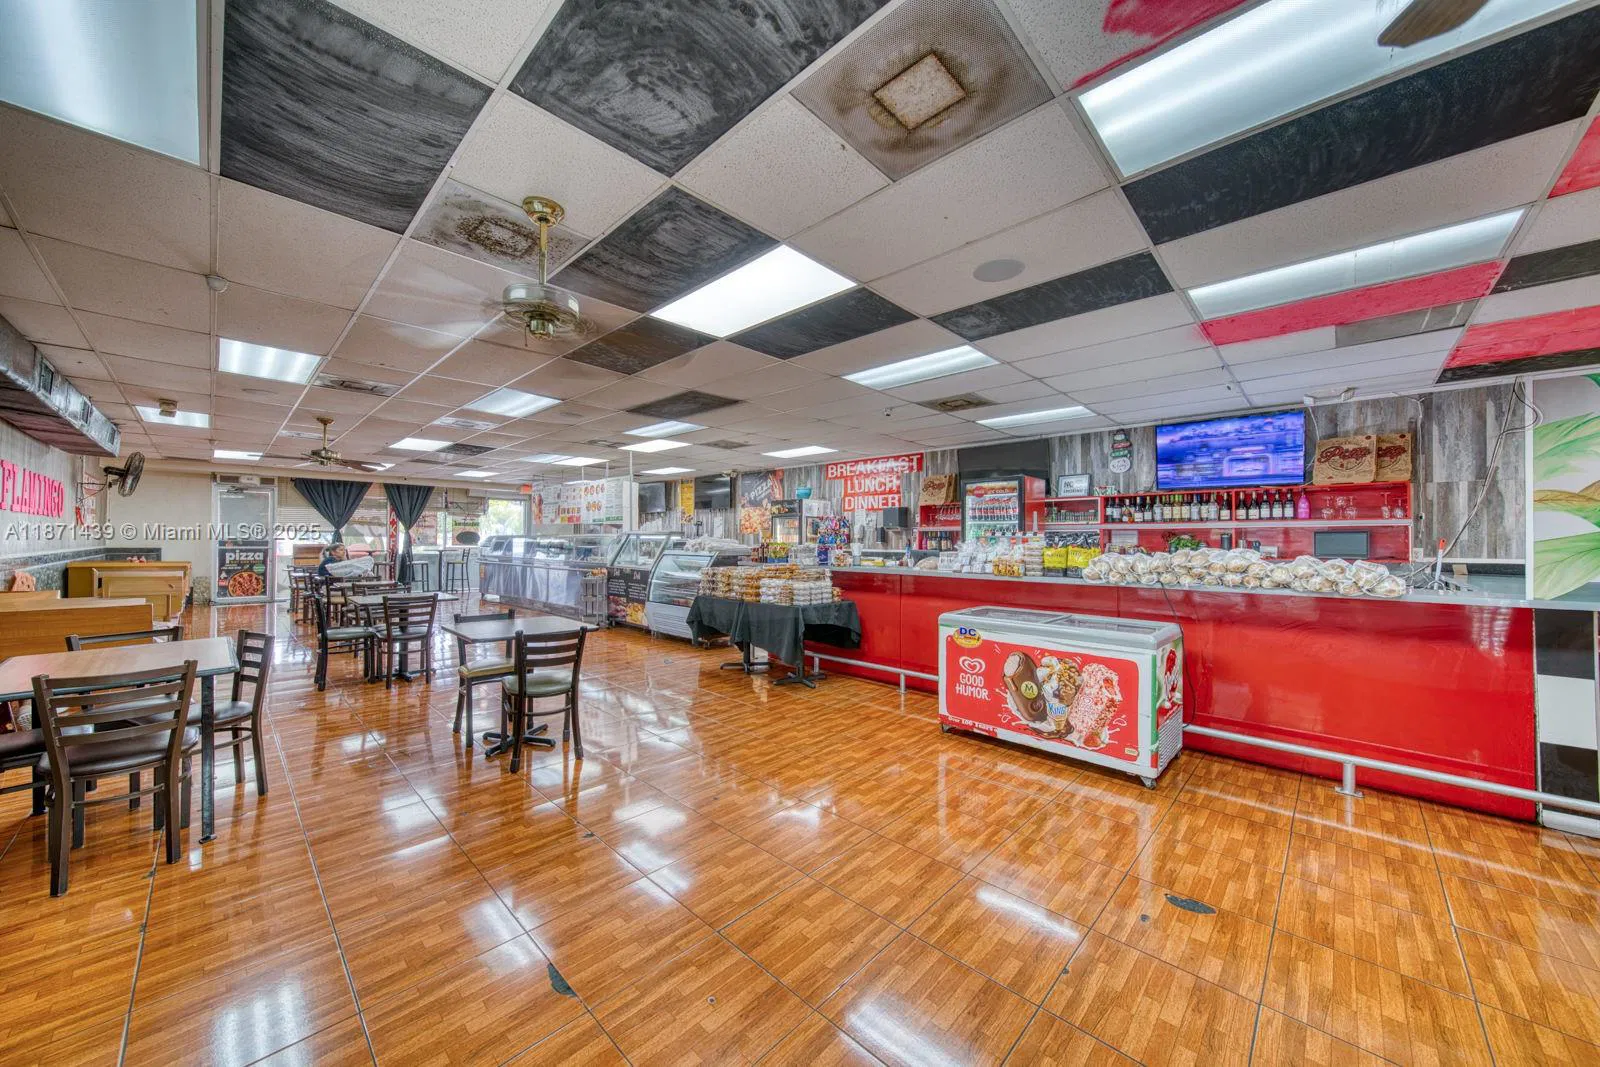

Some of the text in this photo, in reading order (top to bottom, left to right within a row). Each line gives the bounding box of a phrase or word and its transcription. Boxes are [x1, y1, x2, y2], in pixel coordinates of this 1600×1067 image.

[827, 455, 921, 478] BREAKFAST
[0, 459, 65, 519] FLAMINGO
[847, 474, 897, 493] LUNCH
[844, 494, 899, 510] DINNER
[225, 550, 264, 564] pizza
[960, 627, 977, 637] DC
[959, 673, 985, 687] GOOD
[955, 683, 991, 701] HUMOR
